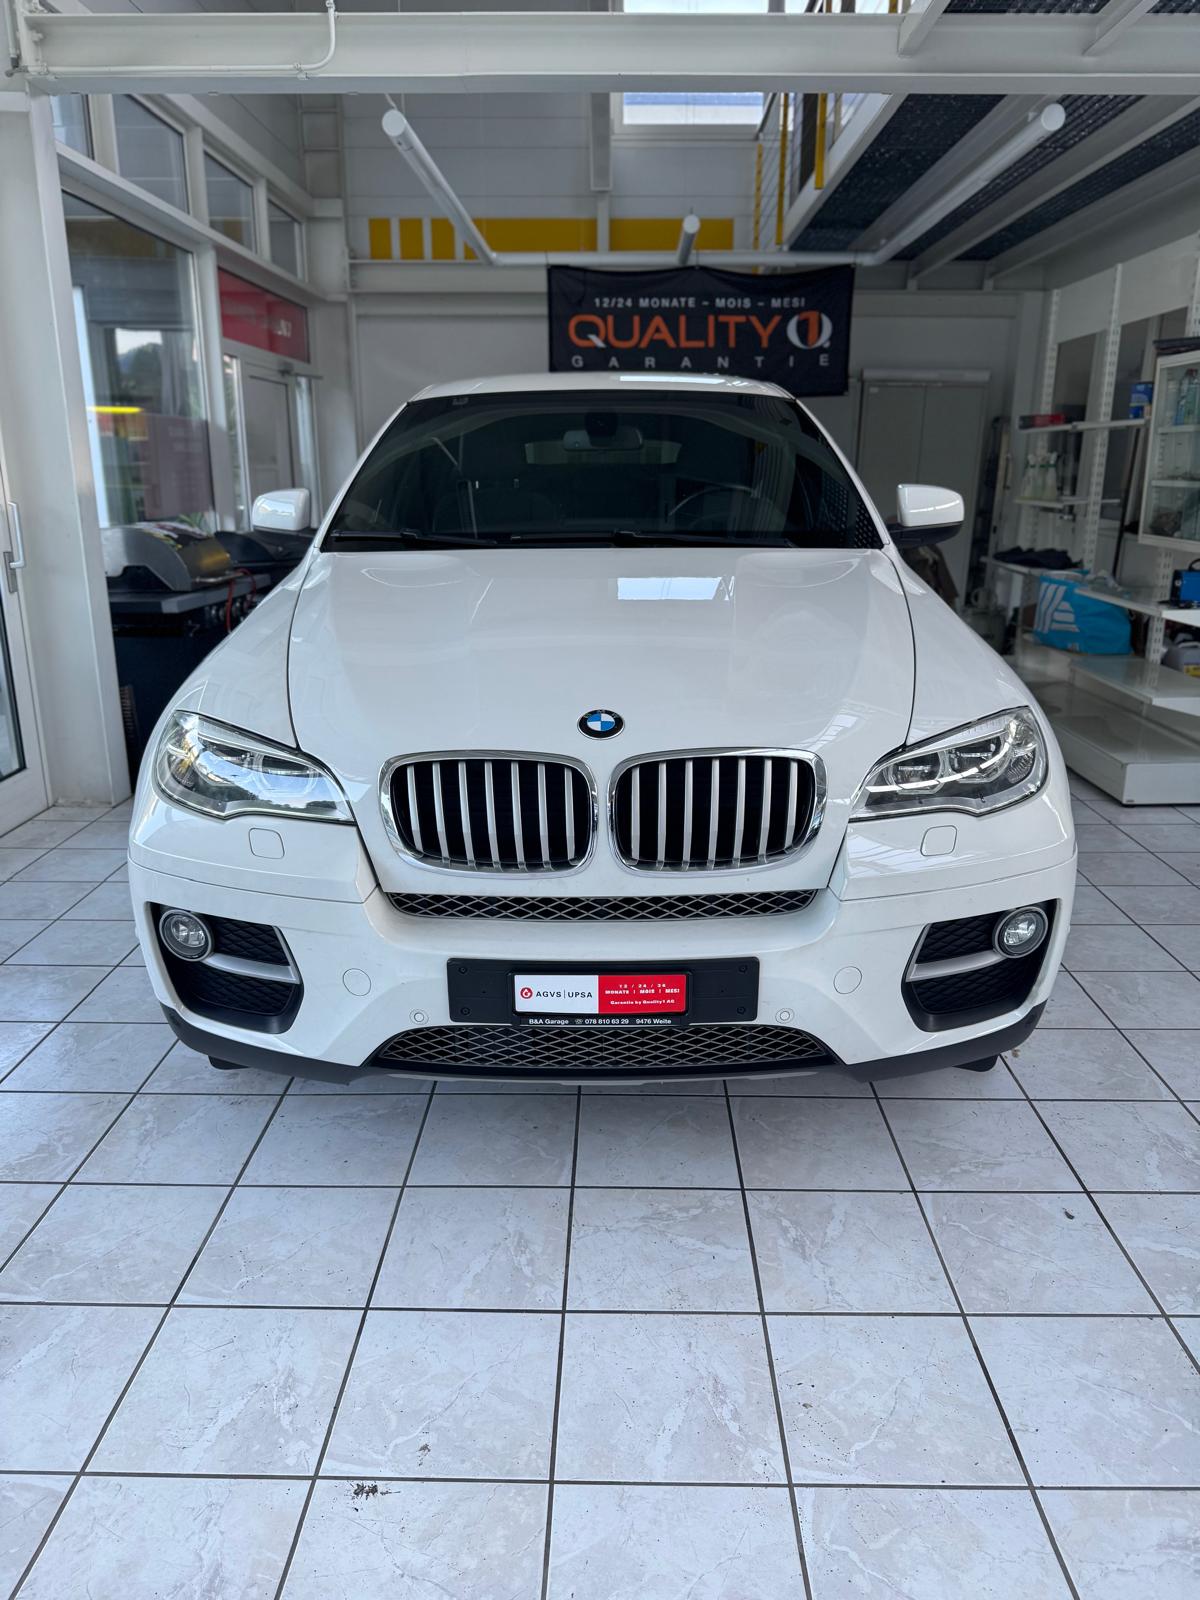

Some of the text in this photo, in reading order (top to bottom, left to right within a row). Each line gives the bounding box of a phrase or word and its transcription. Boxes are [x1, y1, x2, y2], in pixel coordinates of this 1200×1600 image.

[594, 297, 632, 308] 12/24
[639, 297, 696, 308] MONATE
[715, 297, 751, 309] MOIS
[771, 297, 805, 308] MESI
[568, 314, 782, 349] QUALITY
[571, 354, 831, 369] GARANTIE
[544, 1018, 569, 1026] Garage
